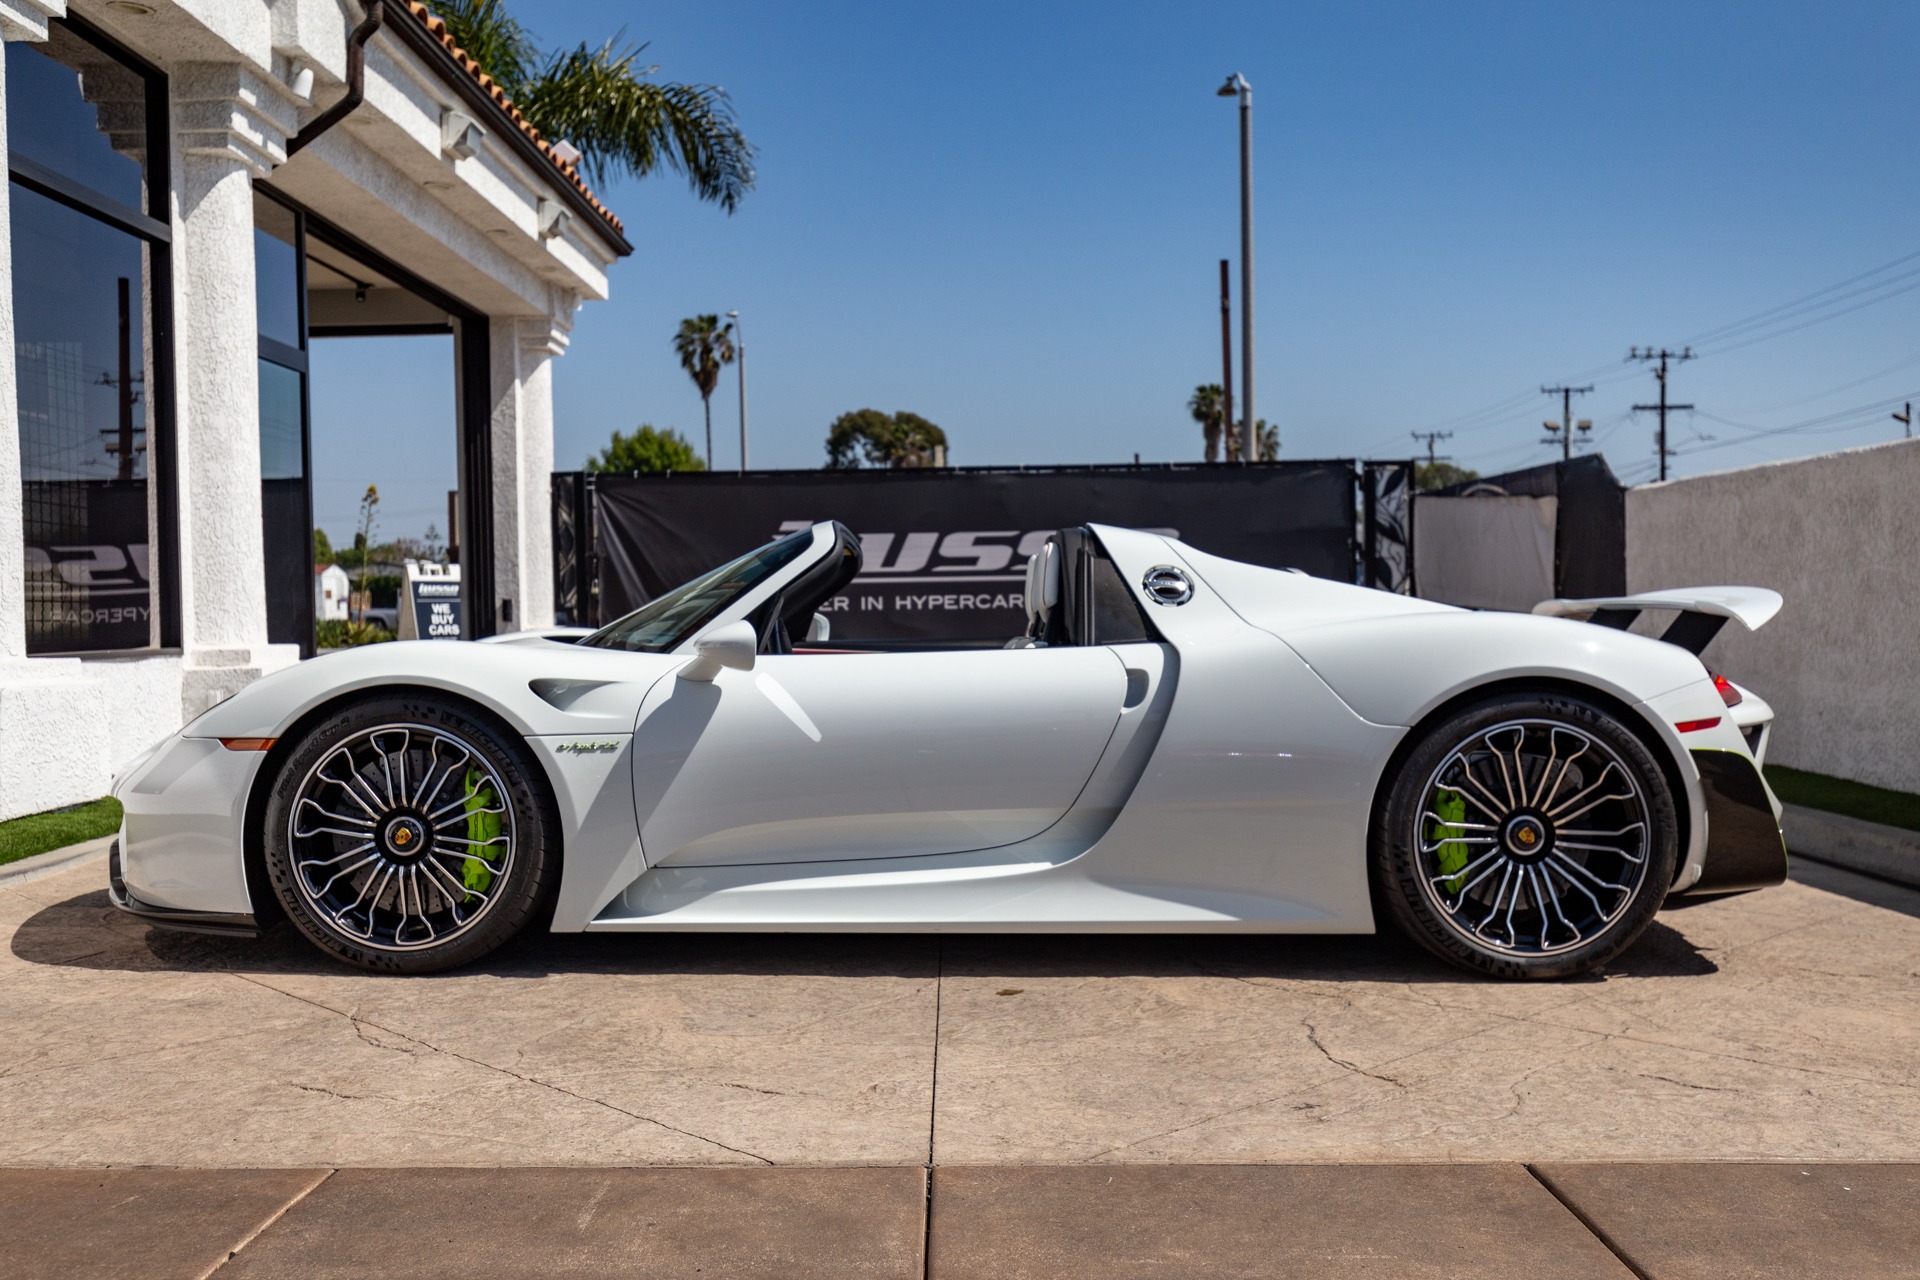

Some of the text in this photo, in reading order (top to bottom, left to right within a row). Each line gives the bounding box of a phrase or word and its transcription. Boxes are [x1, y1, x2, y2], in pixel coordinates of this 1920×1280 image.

[431, 603, 451, 614] WE
[861, 596, 884, 611] IN
[895, 594, 1027, 610] HYPERCAR
[431, 613, 455, 625] BUY
[428, 624, 460, 636] CARS
[282, 888, 343, 953] MICHELIN
